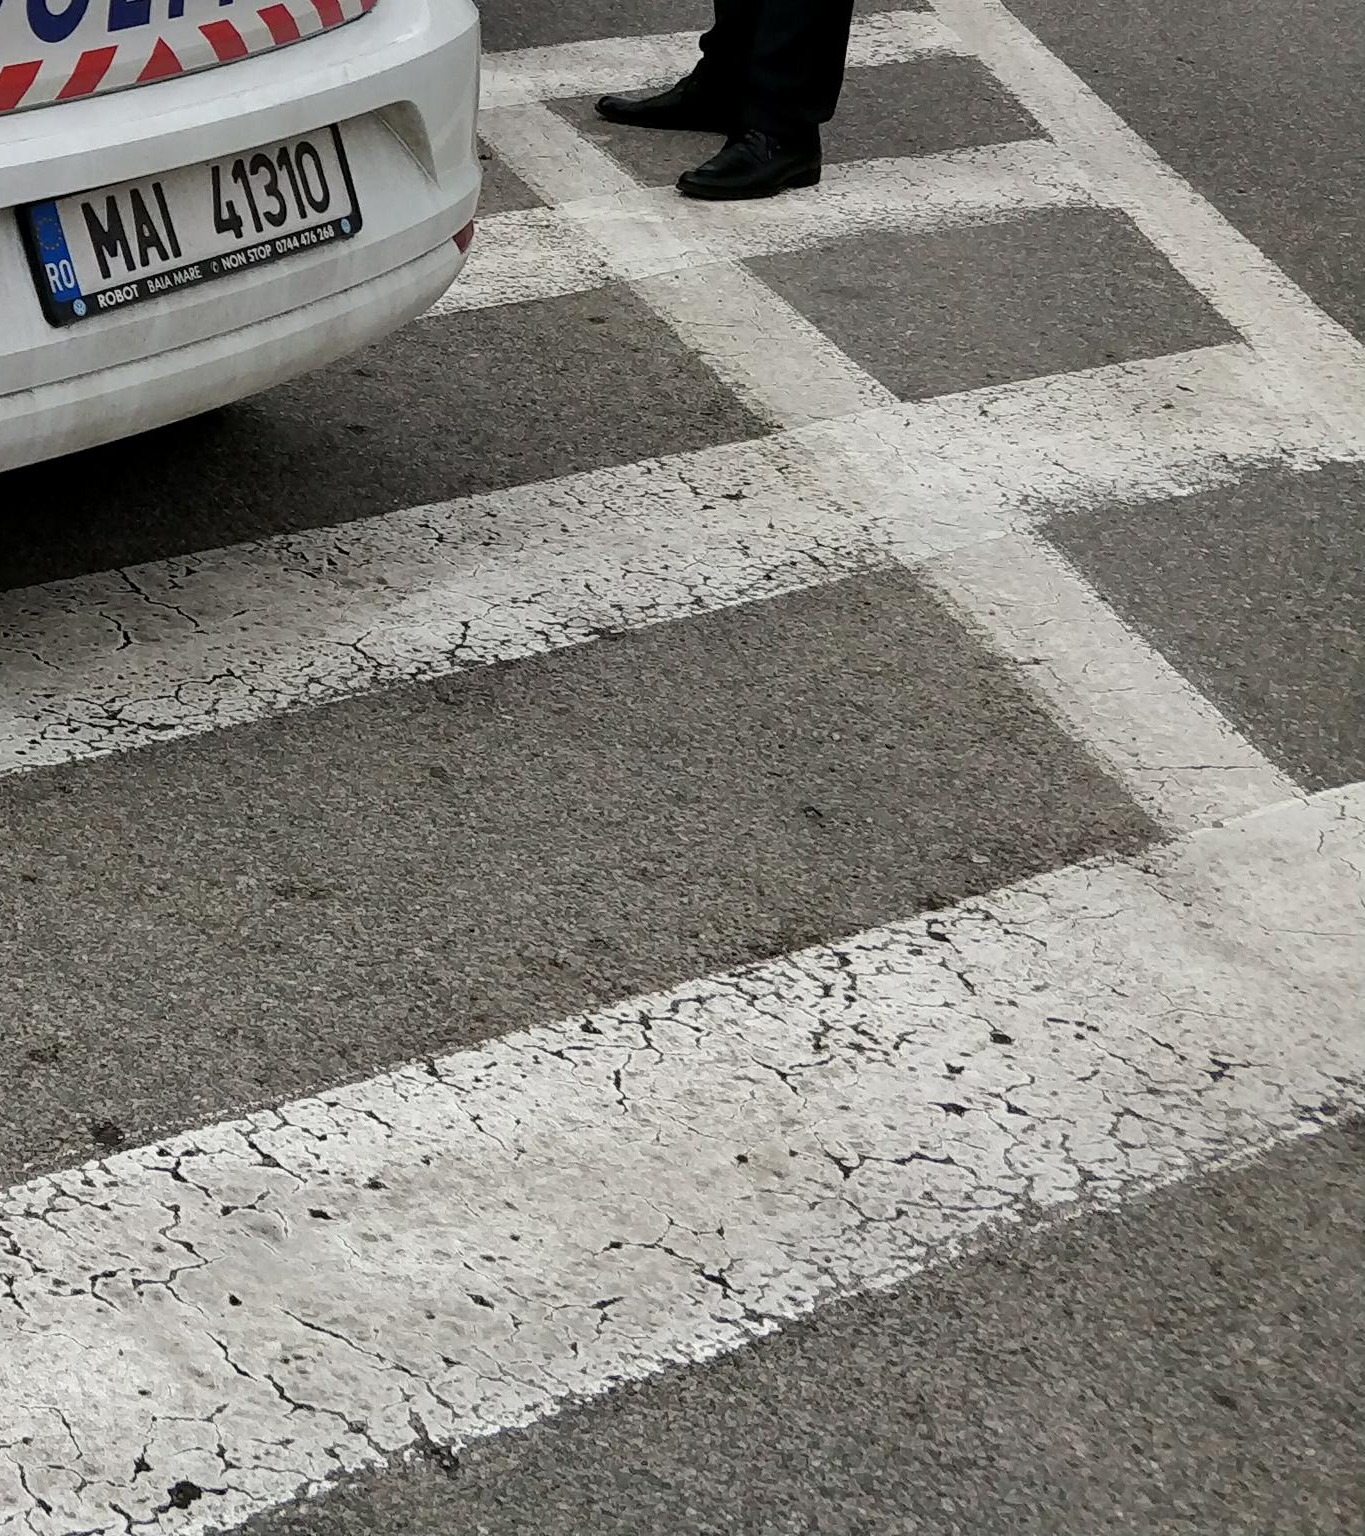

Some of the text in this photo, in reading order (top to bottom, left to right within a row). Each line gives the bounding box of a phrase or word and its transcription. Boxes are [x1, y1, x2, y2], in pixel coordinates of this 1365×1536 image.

[45, 141, 331, 293] RO MAI 41310
[97, 225, 335, 309] ROBOT BAIA MARE NON STOP 0744 476 268
